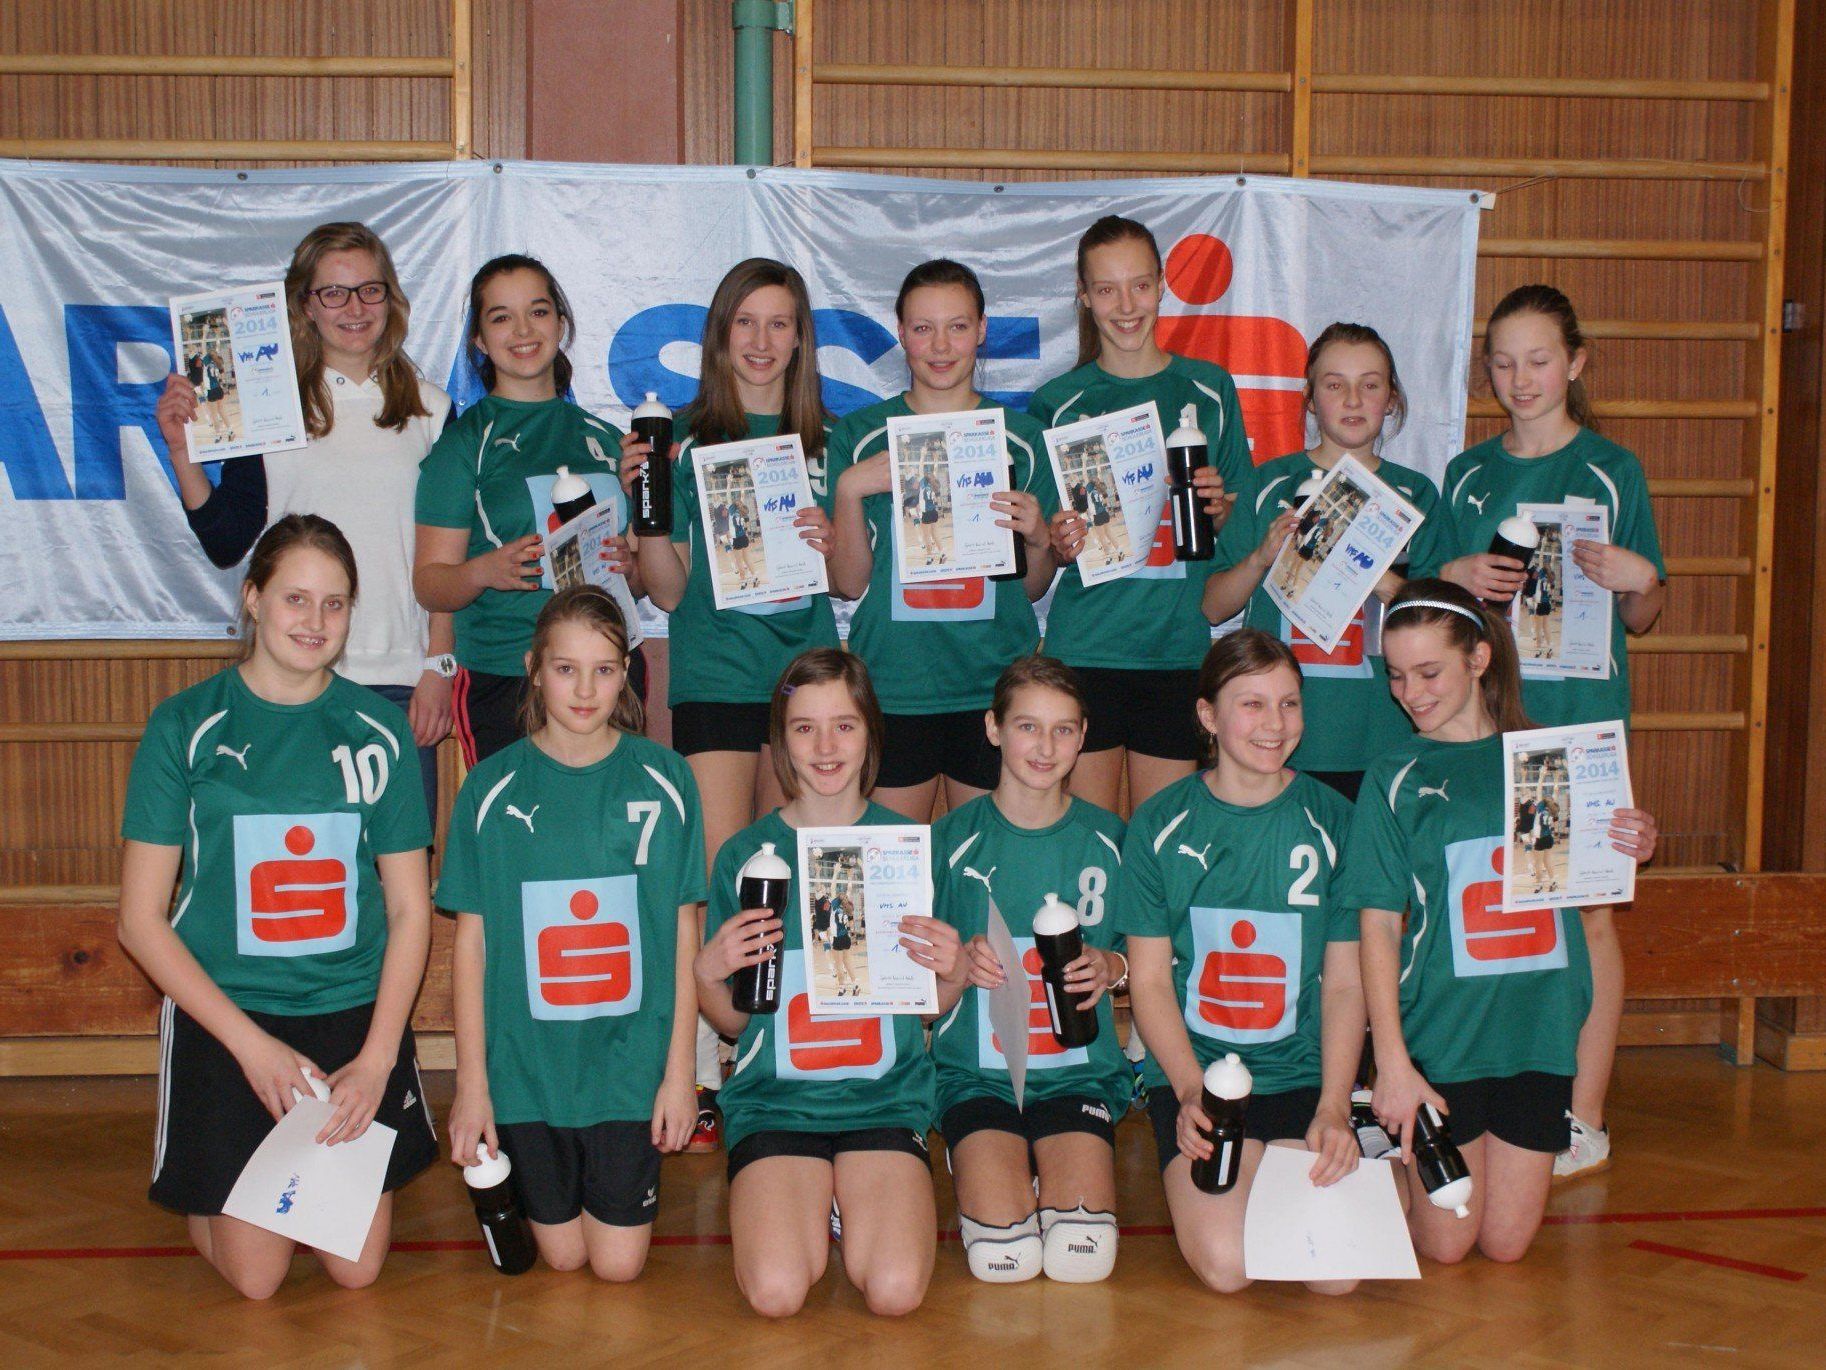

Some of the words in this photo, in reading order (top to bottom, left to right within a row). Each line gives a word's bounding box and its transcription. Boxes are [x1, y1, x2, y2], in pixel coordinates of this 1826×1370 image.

[234, 317, 278, 336] 2014
[953, 444, 996, 459] 2014
[1113, 438, 1156, 459] 2014
[757, 467, 799, 484] 2014
[1357, 515, 1397, 549] 2014
[332, 744, 390, 804] 10
[1575, 761, 1619, 779] 2014
[627, 801, 661, 865] 7
[870, 865, 920, 880] 2014
[1288, 844, 1319, 906] 2
[1077, 866, 1107, 926] 8
[1068, 1243, 1096, 1254] PUMA
[988, 1261, 1016, 1271] PUMA
